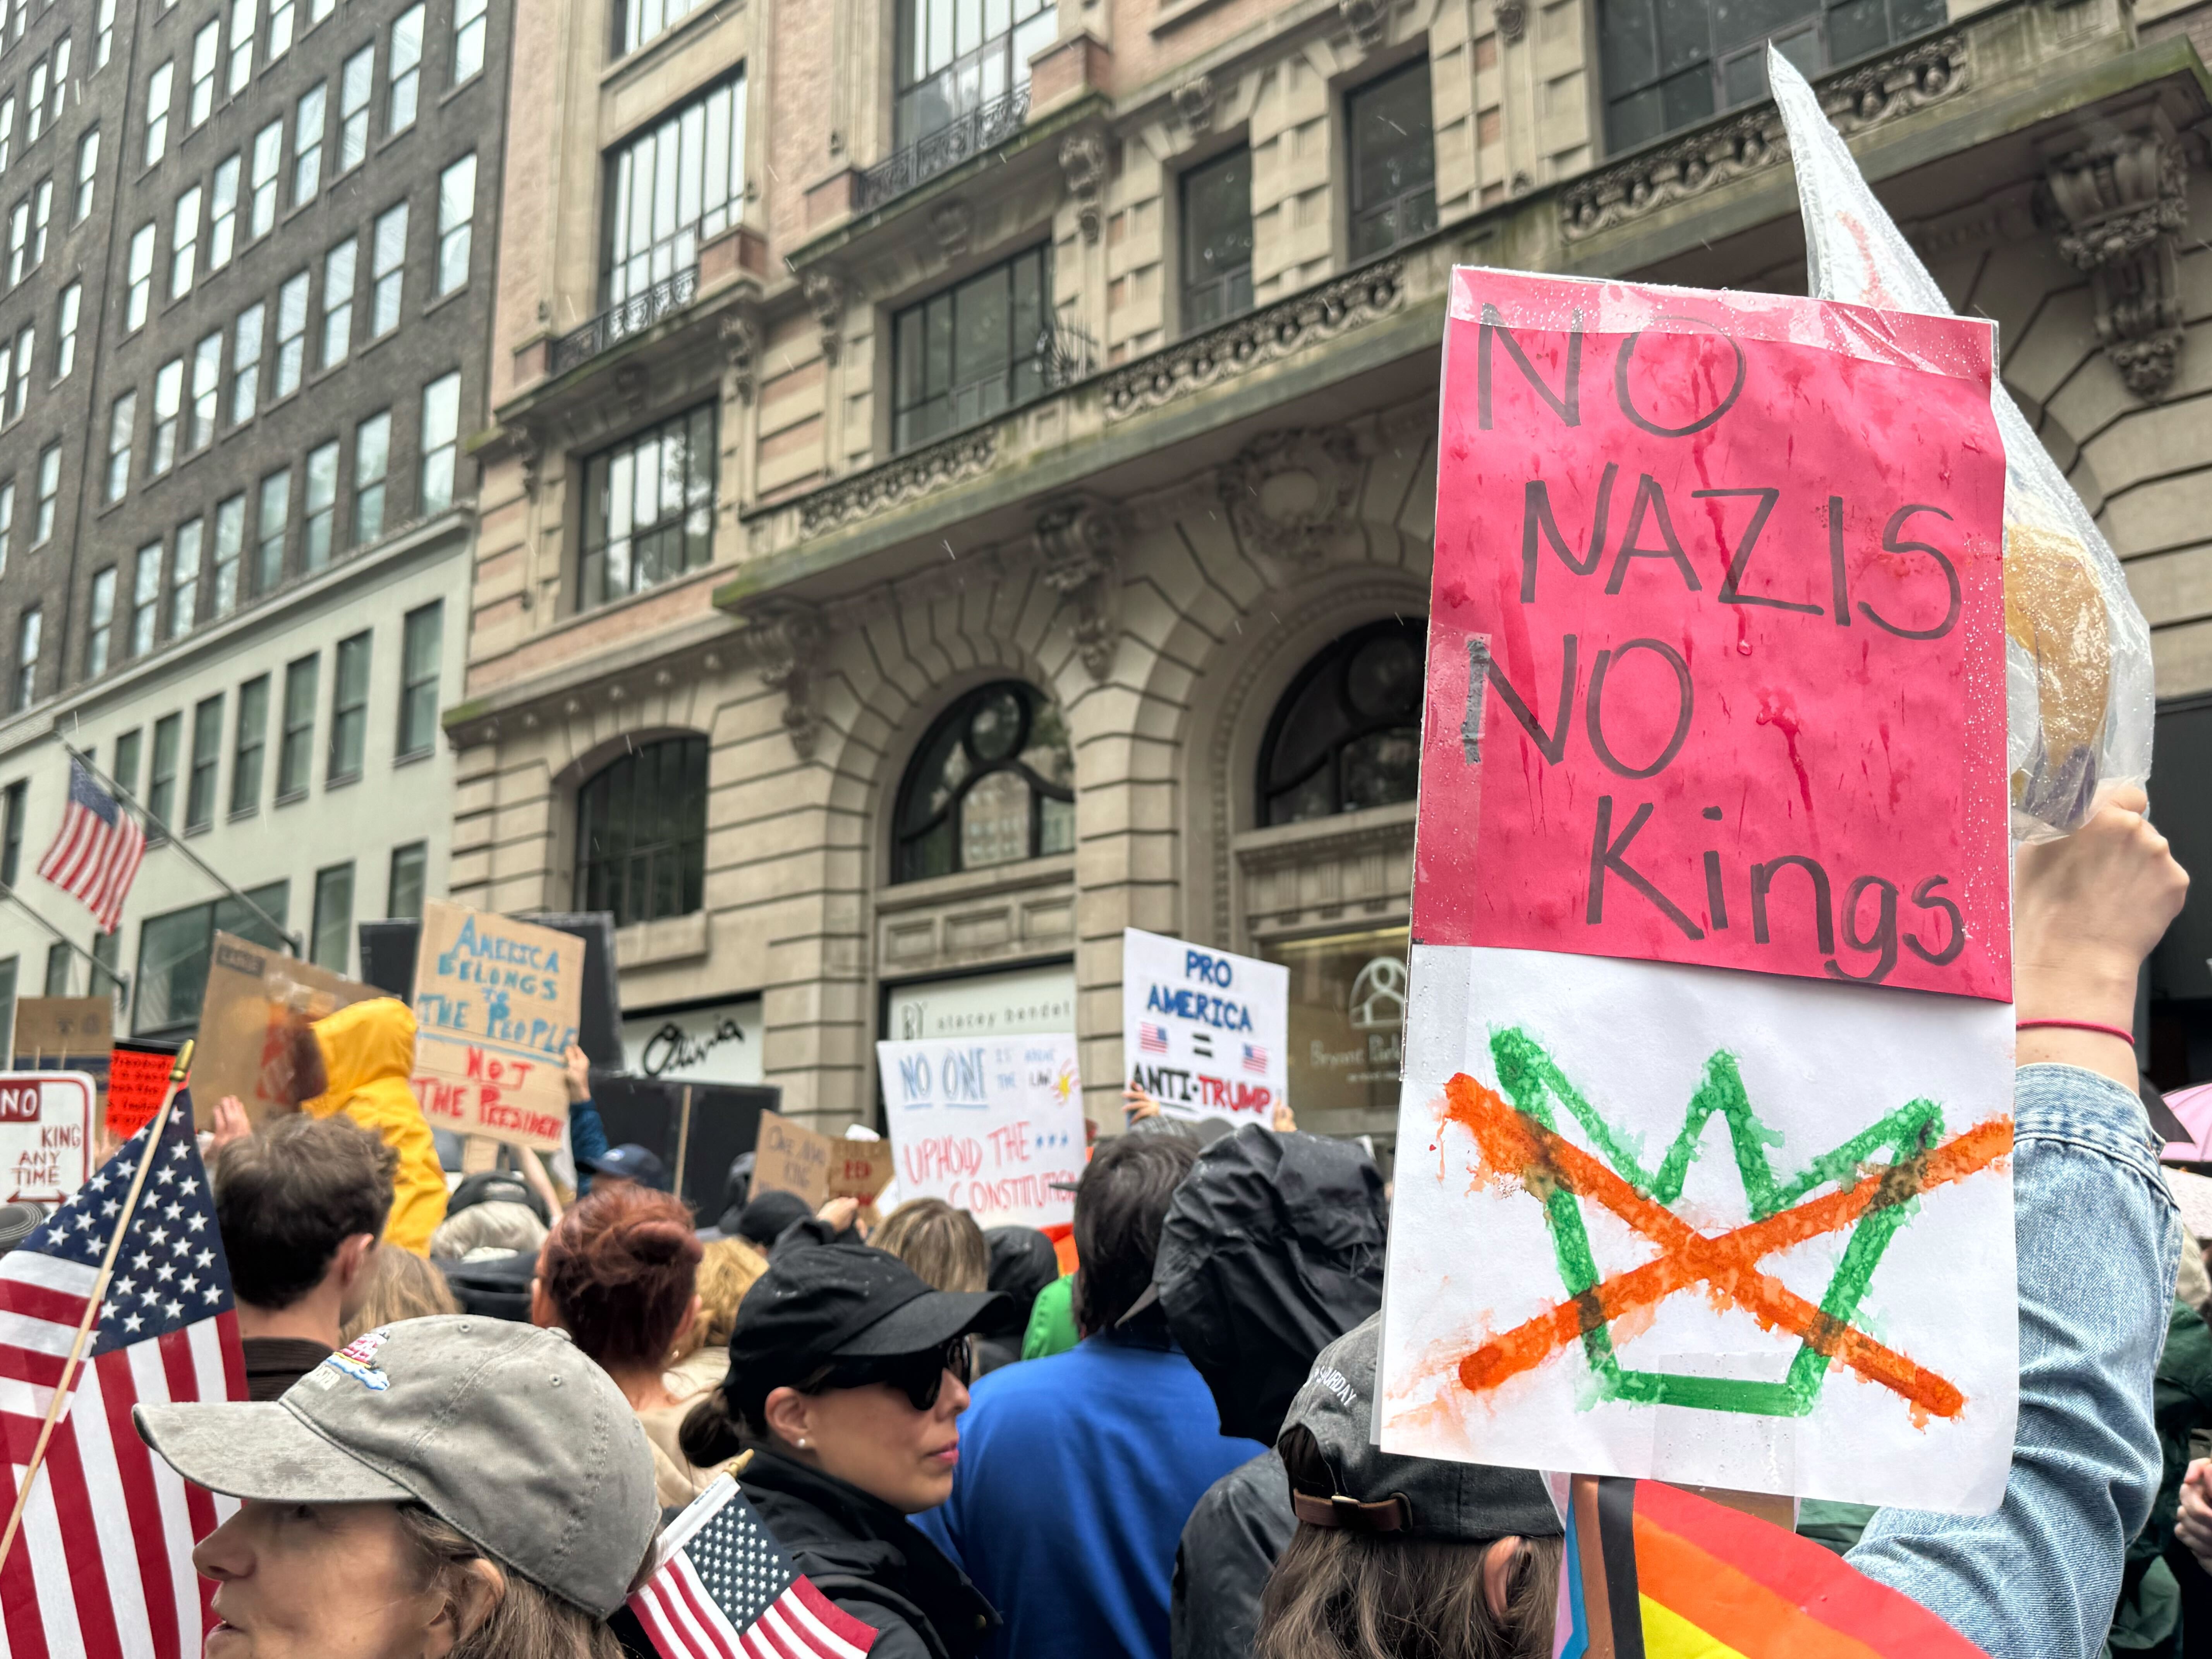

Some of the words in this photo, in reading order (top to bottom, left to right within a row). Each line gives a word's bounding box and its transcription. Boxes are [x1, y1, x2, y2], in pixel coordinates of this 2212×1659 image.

[1478, 303, 1745, 437] NO
[1520, 462, 1962, 640] NAZIS
[1465, 632, 1693, 779] NO
[1585, 794, 1965, 984] Kings
[1184, 950, 1232, 988] PRO
[418, 992, 471, 1029] THE
[1146, 982, 1252, 1031] AMERICA
[467, 1045, 534, 1091] NOT
[899, 1053, 932, 1101] NO
[941, 1046, 986, 1101] ONE
[0, 1088, 38, 1117] NO
[412, 1077, 468, 1118] THE
[19, 1150, 60, 1165] ANY
[41, 1124, 81, 1147] KING
[988, 1121, 1030, 1168] THE
[10, 1166, 59, 1185] TIME
